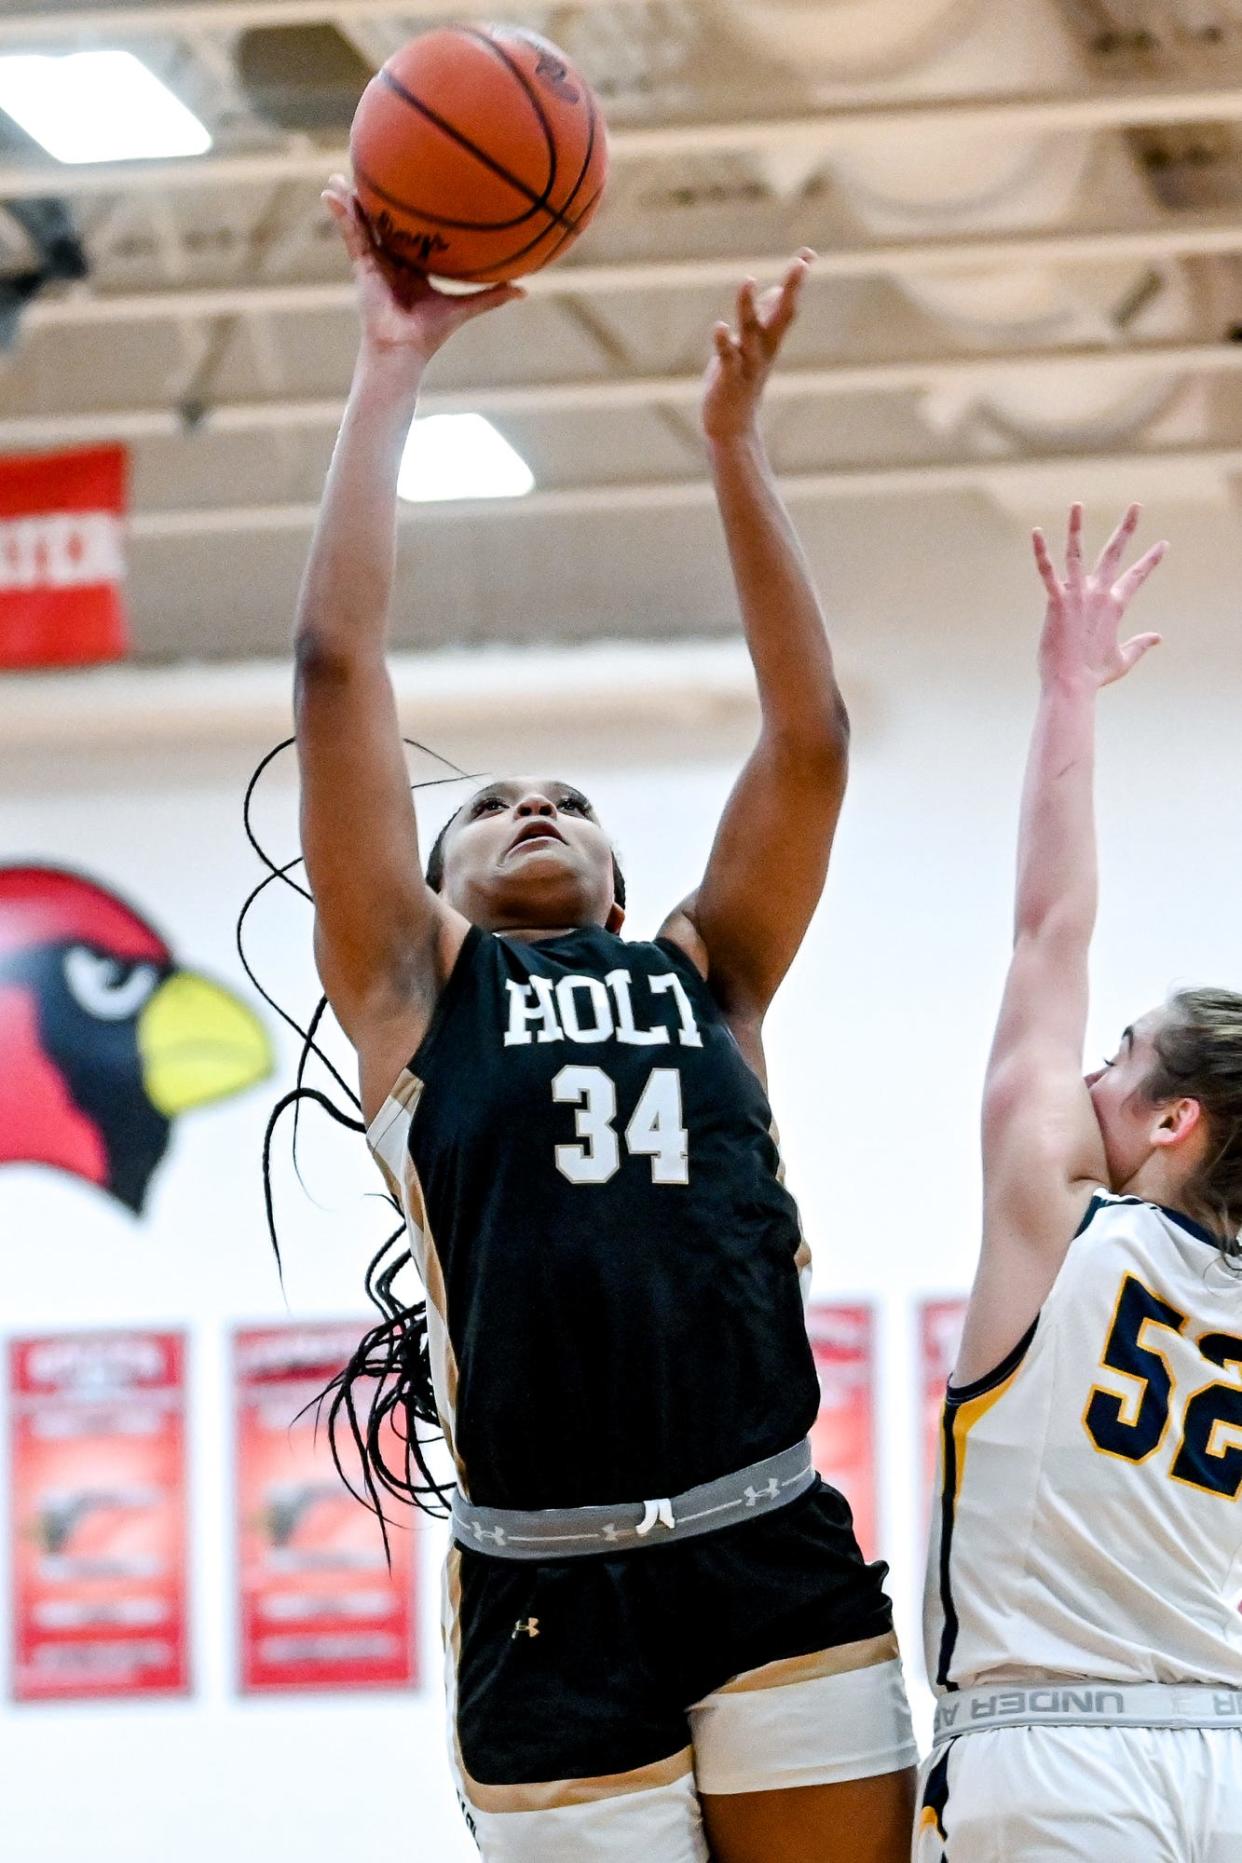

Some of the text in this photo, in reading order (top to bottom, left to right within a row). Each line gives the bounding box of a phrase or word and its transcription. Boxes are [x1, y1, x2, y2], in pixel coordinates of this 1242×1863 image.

[503, 969, 703, 1047] HOLT
[551, 1065, 689, 1184] 34
[1082, 1271, 1242, 1502] 52
[971, 1691, 1124, 1718] UNDER
